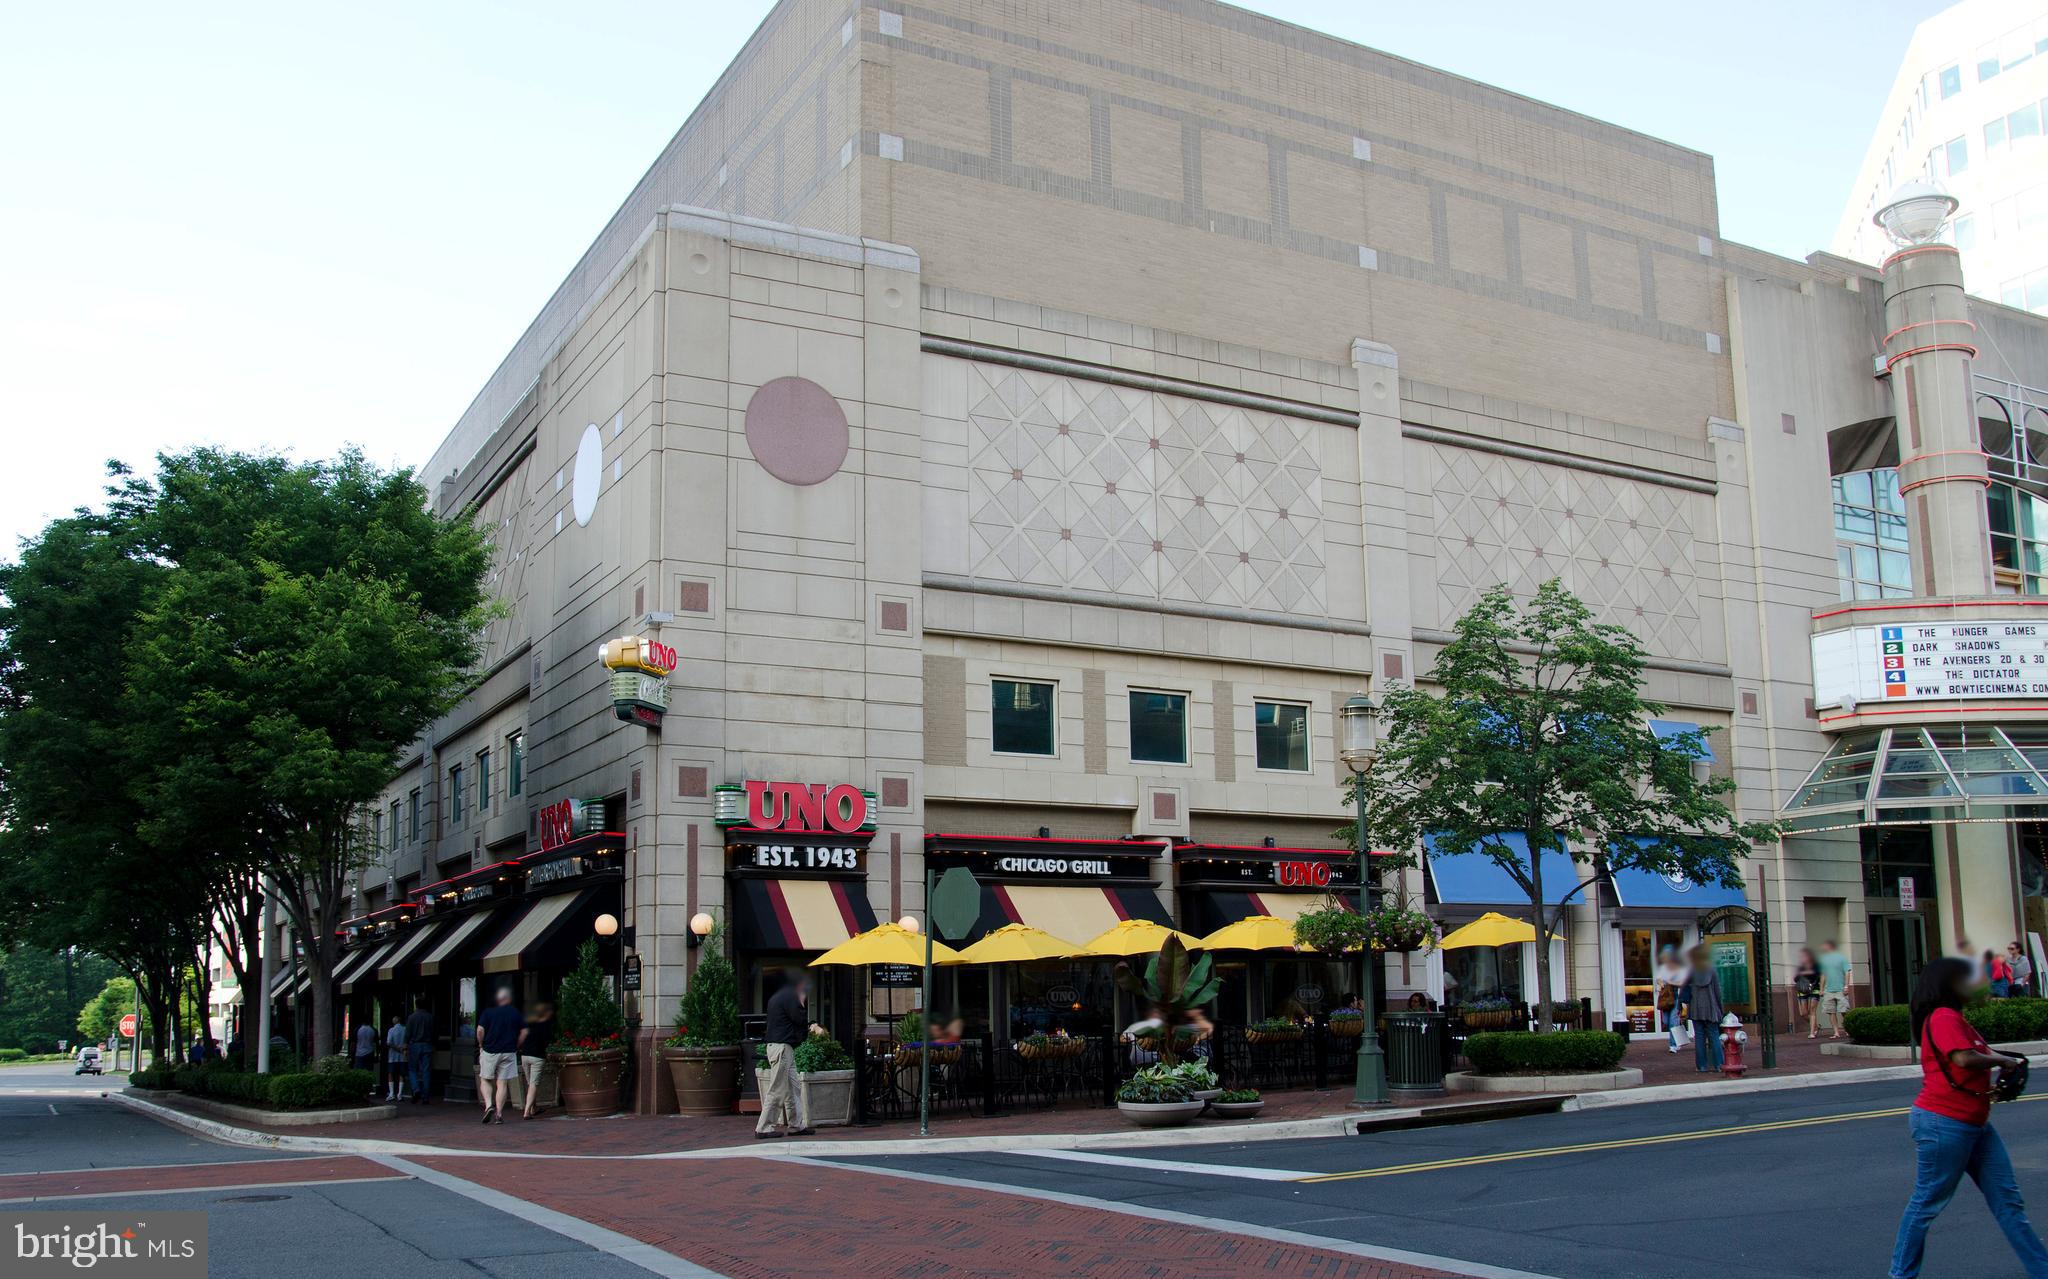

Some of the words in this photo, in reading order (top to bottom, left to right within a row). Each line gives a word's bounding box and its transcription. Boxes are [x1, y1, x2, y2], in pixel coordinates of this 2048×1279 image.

[1888, 630, 1896, 638] 1
[1918, 628, 1936, 637] THE
[1952, 627, 1988, 636] HUNGER
[2004, 626, 2036, 635] GAMES
[1886, 644, 1898, 653] 2
[1912, 643, 1938, 652] DARK
[1955, 641, 2000, 650] SHADOWS
[649, 639, 677, 671] UNO
[1887, 658, 1899, 668] 3
[1913, 657, 1931, 666] THE
[1943, 655, 1990, 665] AVENGERS
[2019, 655, 2026, 664] &
[1888, 672, 1900, 681] 4
[1946, 670, 1963, 679] THE
[1973, 669, 2020, 678] DICTATOR
[1915, 686, 1940, 695] WWW
[1949, 684, 2027, 694] BOWTIECINEMAS
[745, 780, 867, 833] UNO
[540, 799, 573, 851] UNO
[757, 846, 800, 867] EST.
[806, 847, 857, 869] 1943
[1001, 857, 1068, 873] CHICAGO
[1072, 860, 1111, 875] GRILL
[1279, 861, 1331, 886] UNO
[1050, 991, 1077, 1002] UNO
[1299, 989, 1321, 999] UNO
[122, 1021, 135, 1030] STO
